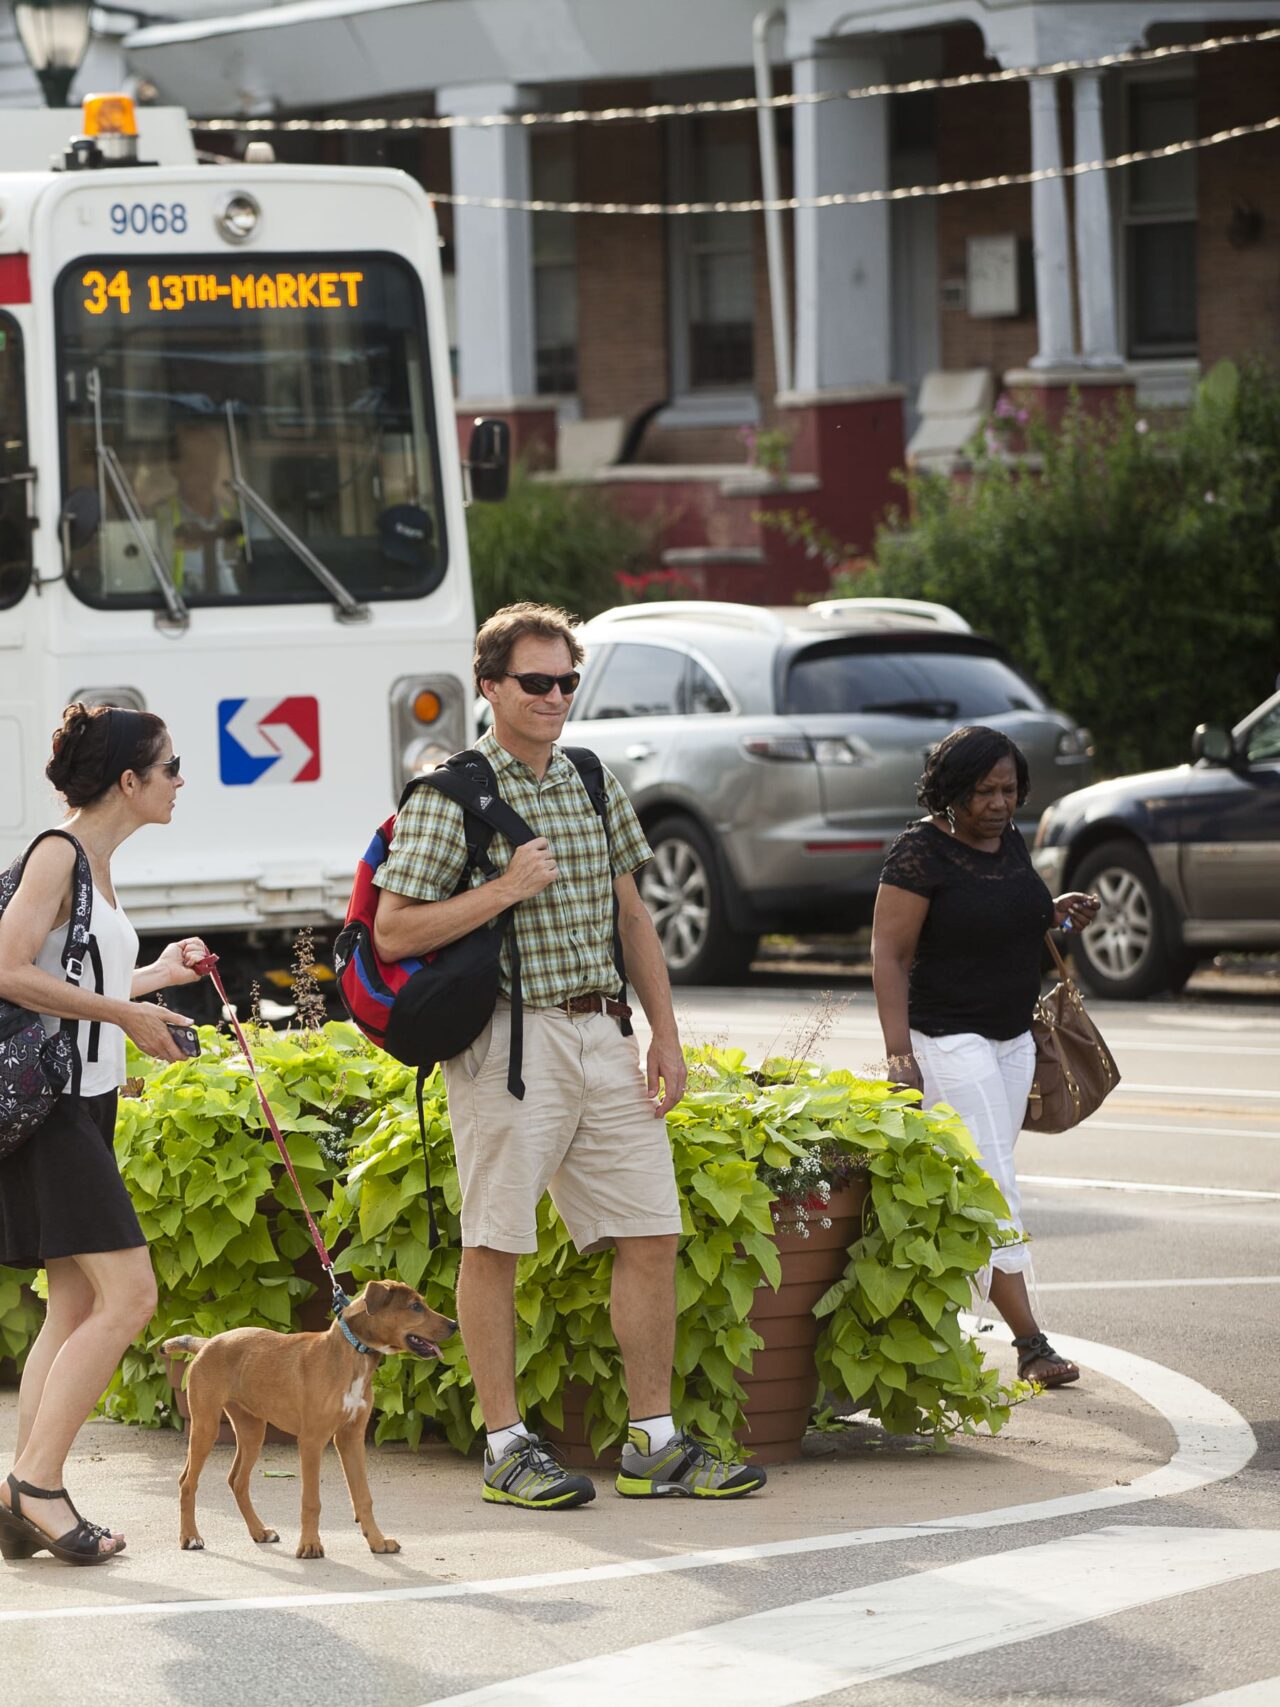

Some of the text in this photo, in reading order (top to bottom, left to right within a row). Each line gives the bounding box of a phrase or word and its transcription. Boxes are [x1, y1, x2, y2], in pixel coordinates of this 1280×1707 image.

[110, 203, 188, 234] 9068
[82, 270, 364, 314] 34 13TH-MARKET
